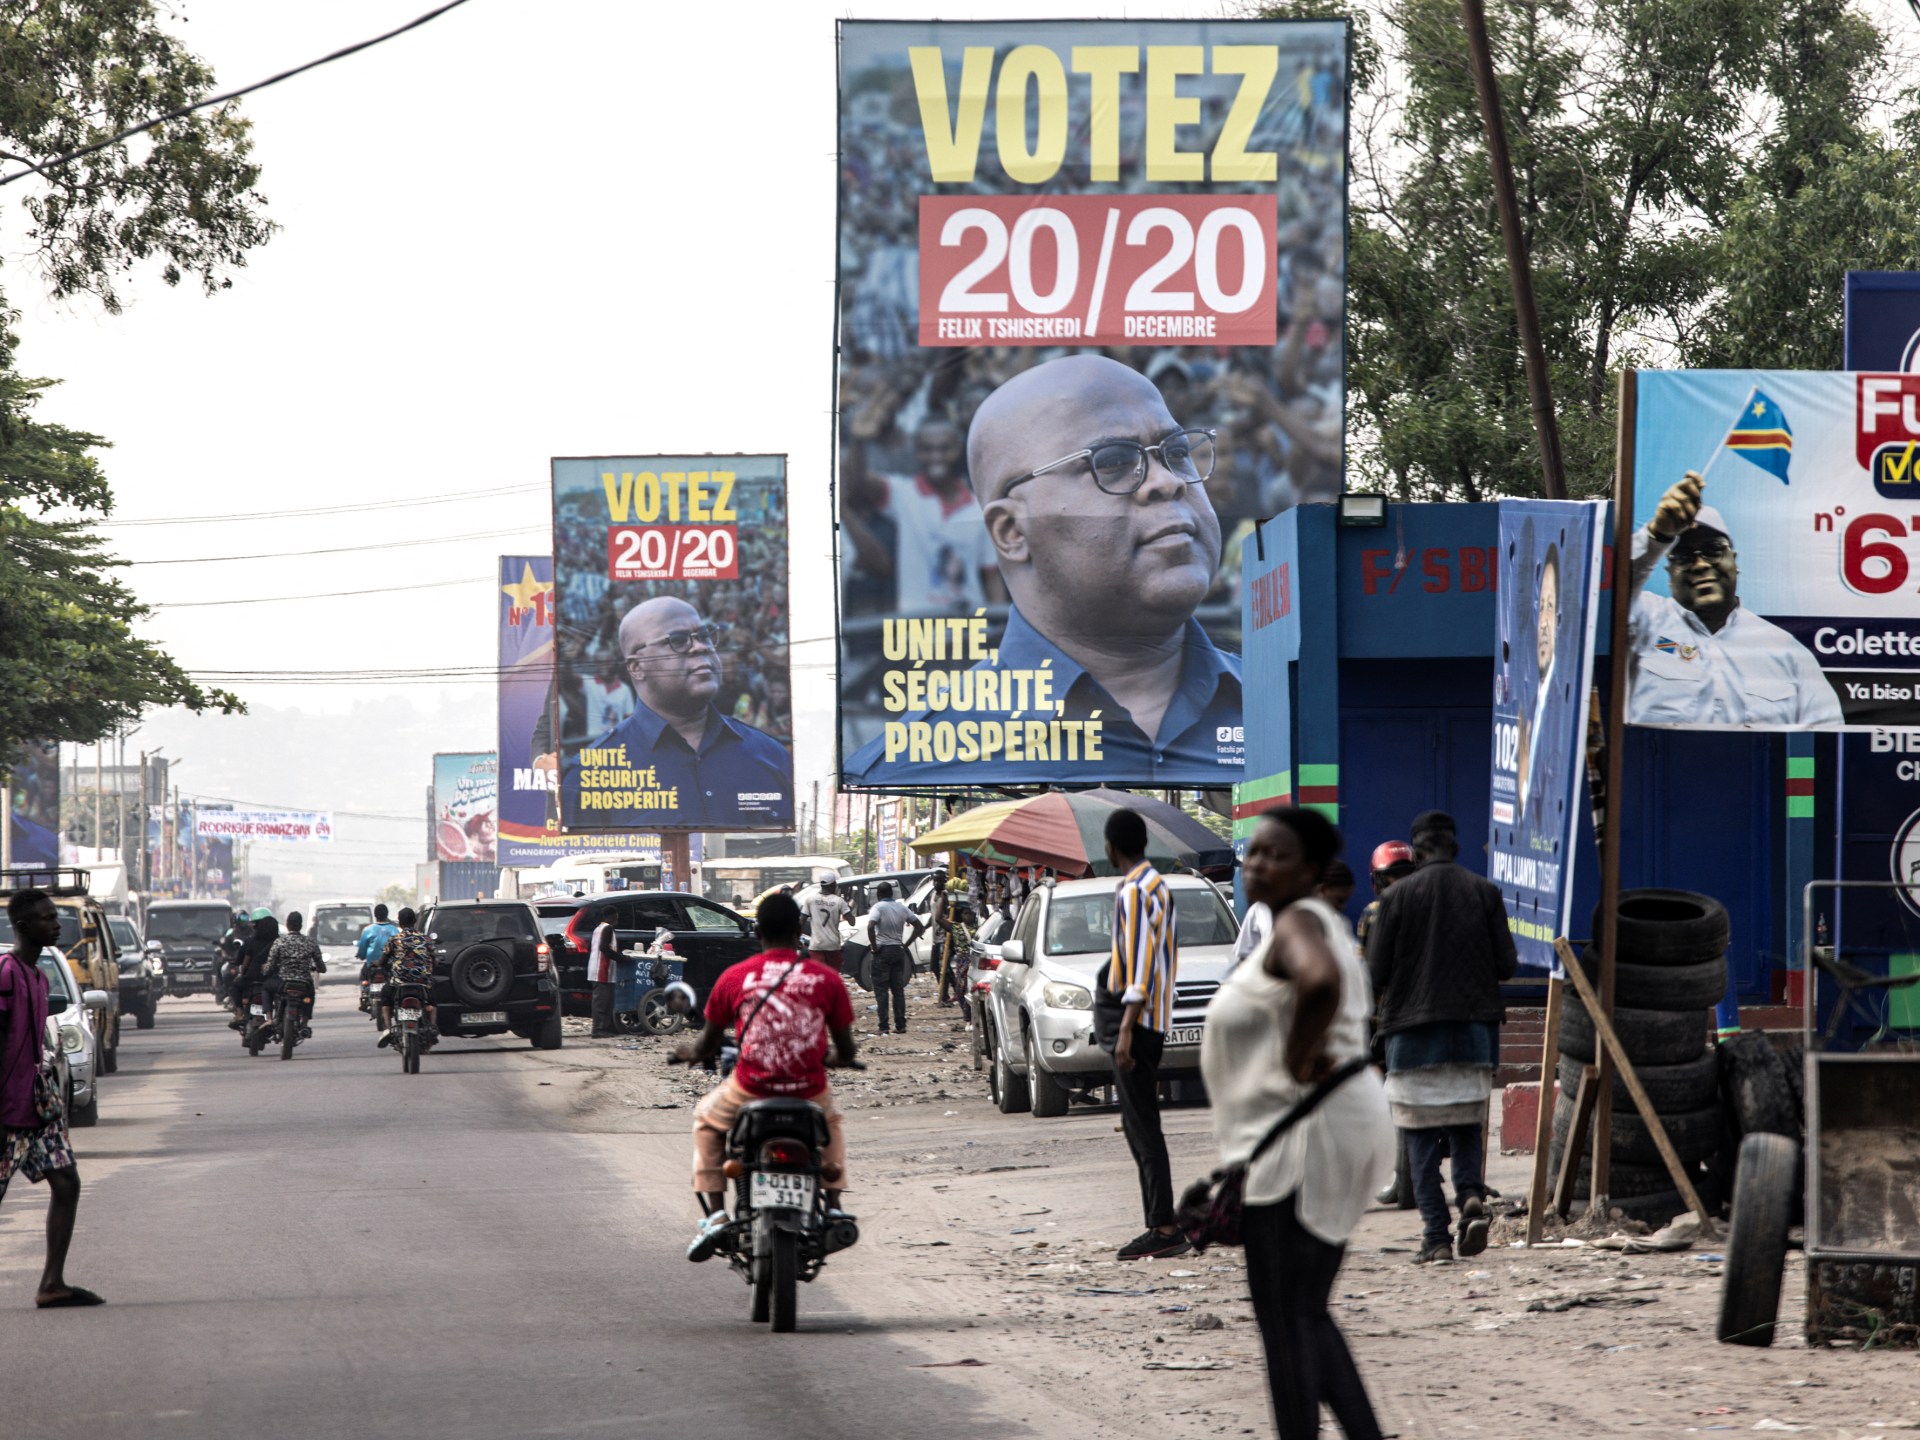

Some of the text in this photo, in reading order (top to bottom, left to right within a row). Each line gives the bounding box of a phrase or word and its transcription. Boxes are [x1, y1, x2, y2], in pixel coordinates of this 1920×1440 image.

[908, 44, 1279, 183] VOTEZ
[938, 207, 1266, 336] 20/20
[938, 315, 1217, 338] FELIX TSHISEKEDI DECEMBRE
[602, 471, 737, 522] VOTEZ
[615, 529, 734, 577] 20/20
[1844, 513, 1920, 594] 6
[683, 567, 718, 578] DECEMBRE
[882, 607, 999, 666] UNITÉ,
[1814, 627, 1920, 656] Colette
[883, 659, 1065, 716] SÉCURITÉ,
[1845, 683, 1870, 699] Ya
[1873, 684, 1911, 700] biso
[885, 710, 1103, 762] PROSPÉRITÉ
[1494, 722, 1518, 772] 102
[579, 744, 632, 769] UNITÉ,
[580, 765, 661, 789] SÉCURITÉ,
[580, 786, 679, 809] PROSPÉRITÉ
[199, 821, 255, 834] RODRIGUE
[510, 847, 566, 858] CHANGEMENT,
[583, 834, 627, 847] Société
[629, 834, 661, 848] Civile
[1493, 850, 1513, 884] MPIA
[819, 908, 831, 927] 7
[1187, 1029, 1201, 1042] 01
[775, 1189, 804, 1206] 311
